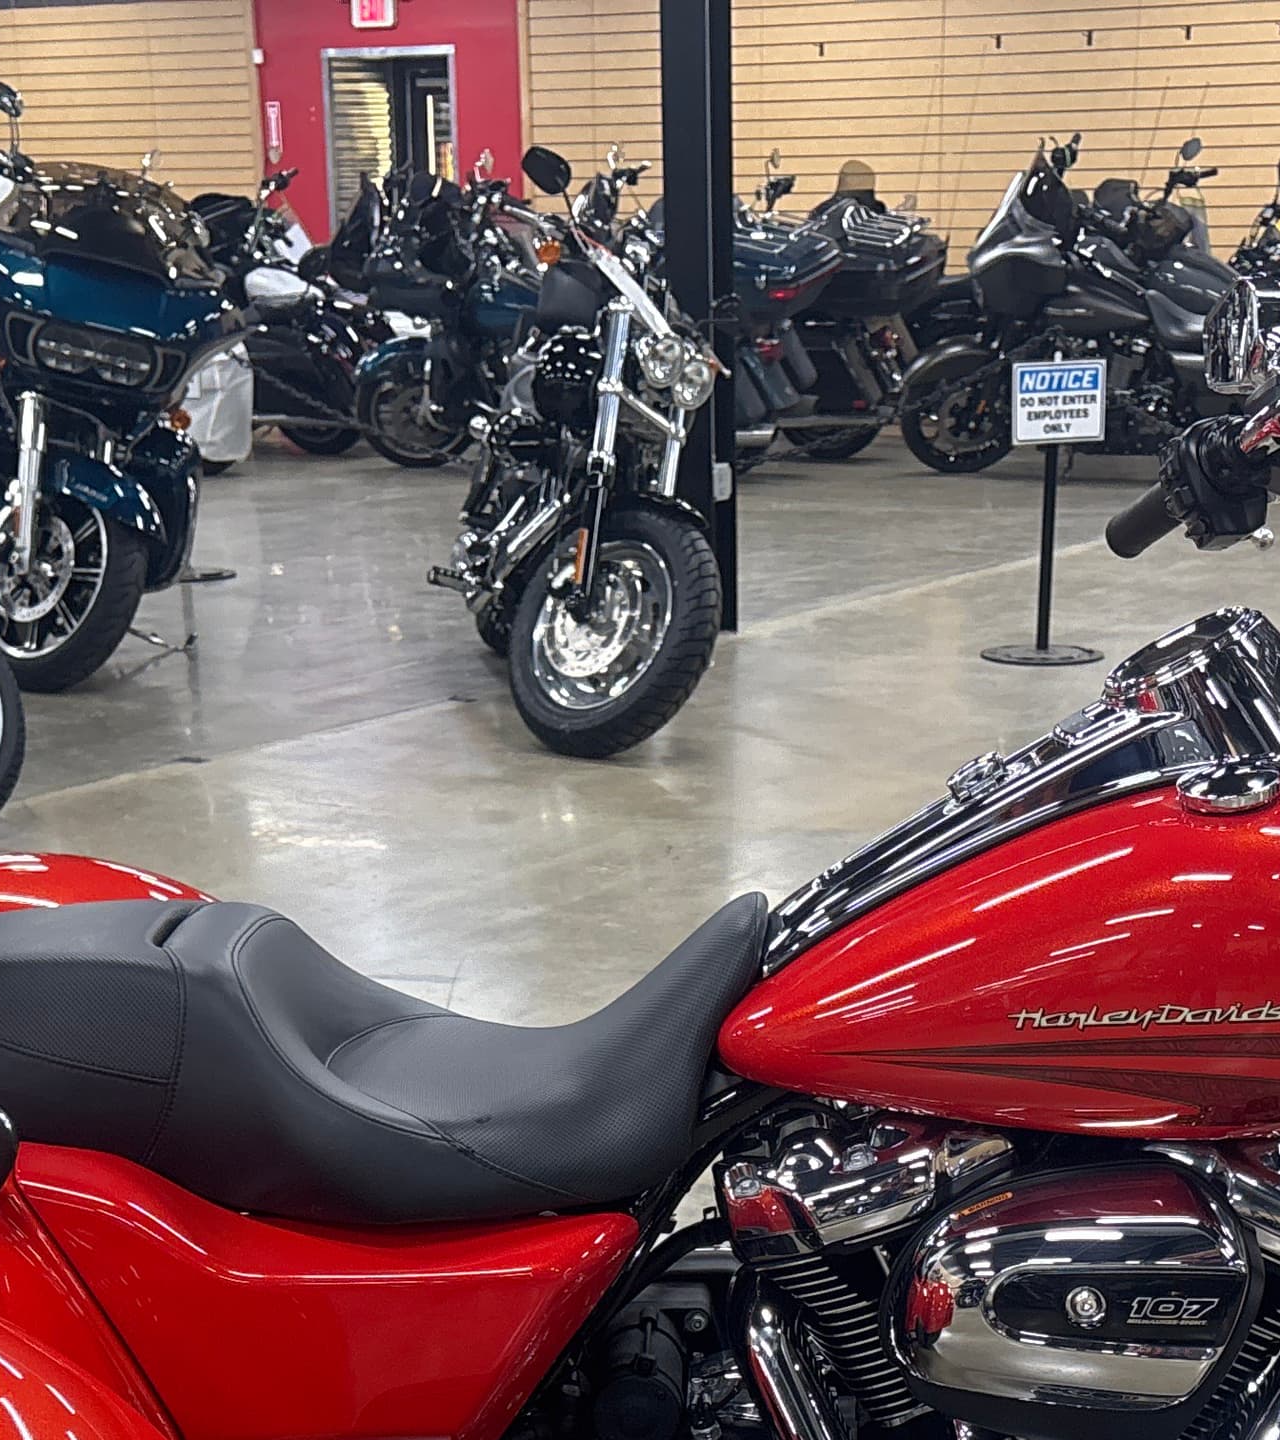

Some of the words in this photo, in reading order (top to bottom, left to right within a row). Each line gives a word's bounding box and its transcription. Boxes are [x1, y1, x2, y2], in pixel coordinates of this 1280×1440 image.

[1022, 370, 1097, 391] NOTICE
[1020, 396, 1035, 408] DO
[1037, 395, 1059, 407] NOT
[1062, 394, 1097, 406] ENTER
[1027, 408, 1089, 421] EMPLOYEES
[1043, 422, 1072, 434] ONLY
[1129, 1297, 1220, 1319] 107
